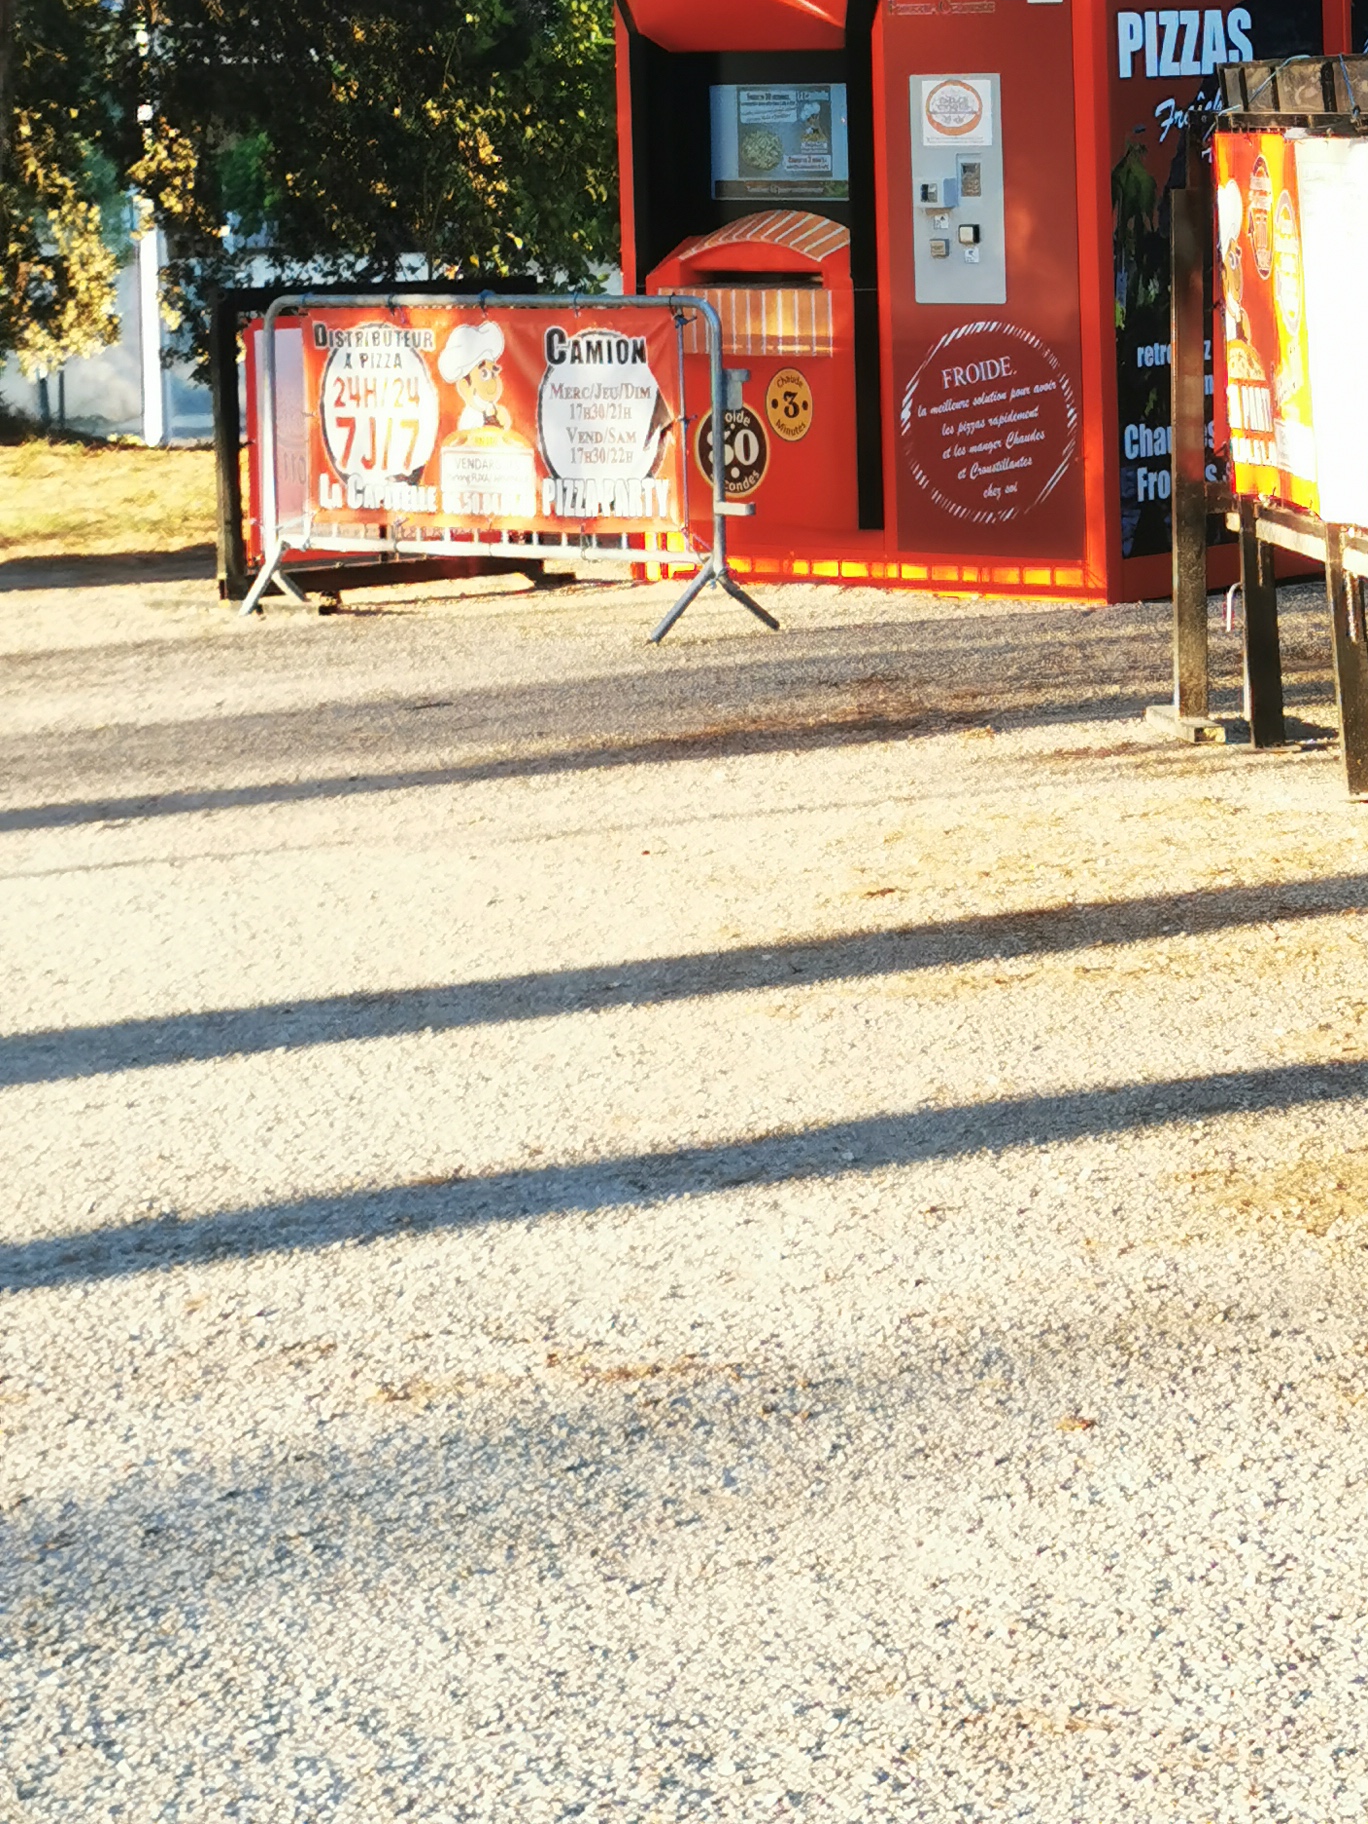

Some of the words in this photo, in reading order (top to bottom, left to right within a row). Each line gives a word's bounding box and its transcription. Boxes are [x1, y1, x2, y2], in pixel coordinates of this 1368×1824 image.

[1117, 8, 1254, 78] PIZZAS
[313, 323, 434, 349] DISTRIBUTEUR
[545, 328, 647, 366] CAMION
[360, 353, 403, 369] PIZZA
[941, 356, 1017, 389] FROIDE.
[333, 376, 420, 409] 24H/24
[549, 382, 652, 400] MERC/JEU/DIM
[783, 391, 800, 419] 3
[972, 391, 1007, 408] solution
[1010, 387, 1030, 400] pour
[1033, 380, 1057, 395] avoir
[775, 418, 806, 437] Minutes
[957, 418, 985, 434] pizzas
[989, 405, 1040, 428] rapidement
[336, 417, 420, 471] 7J/7
[566, 426, 637, 444] VEND/SAM
[969, 440, 1002, 456] manger
[1005, 429, 1046, 450] Chaudes
[969, 456, 1033, 480] Croustillantes
[542, 478, 599, 517] PIZZA
[599, 478, 671, 517] PARTY
[983, 486, 1002, 501] chez
